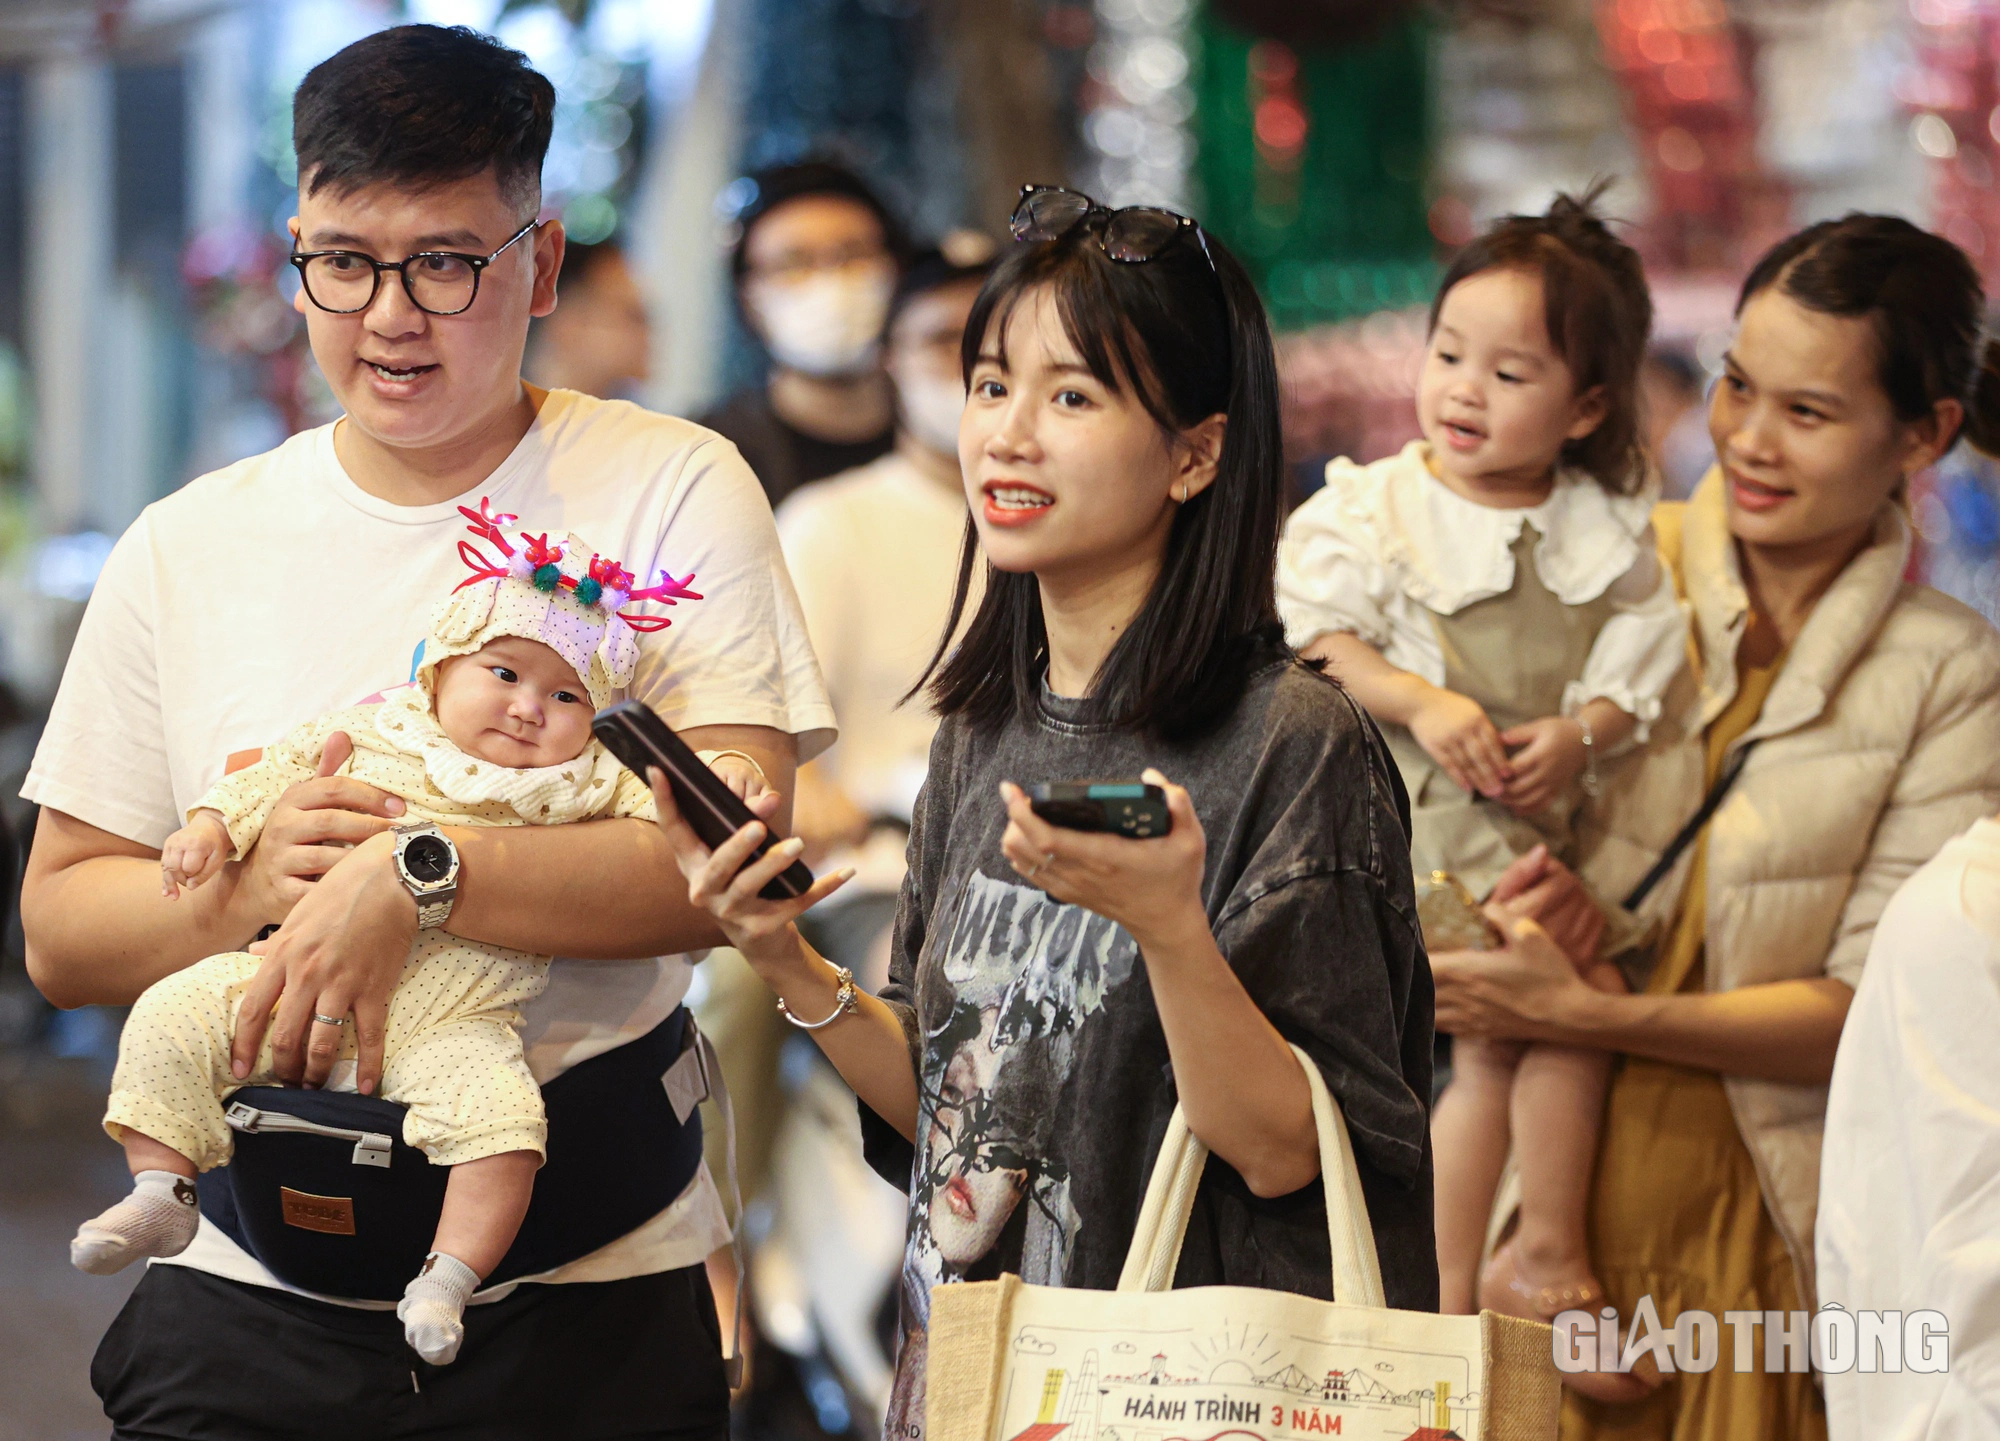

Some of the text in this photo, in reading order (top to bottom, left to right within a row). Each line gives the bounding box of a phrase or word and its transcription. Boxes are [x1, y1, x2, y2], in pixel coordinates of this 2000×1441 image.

[1124, 1393, 1342, 1435] HÀNH TRÌNH 3 NĂM
